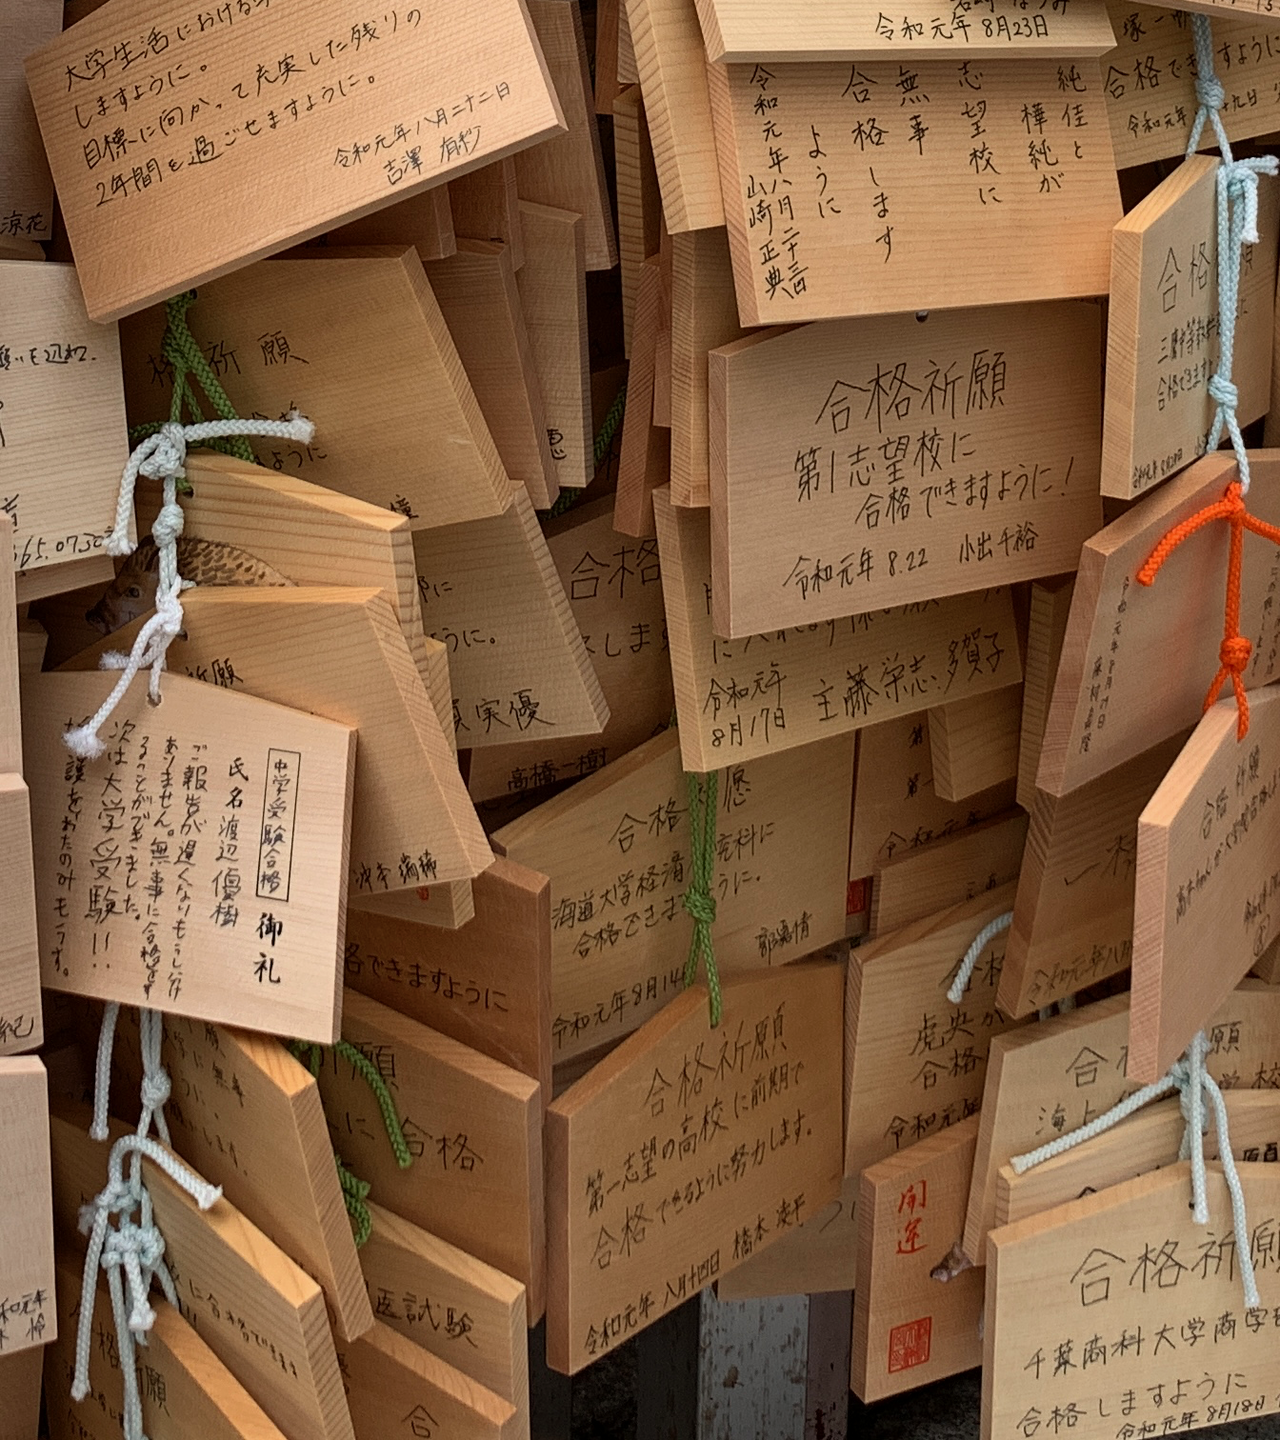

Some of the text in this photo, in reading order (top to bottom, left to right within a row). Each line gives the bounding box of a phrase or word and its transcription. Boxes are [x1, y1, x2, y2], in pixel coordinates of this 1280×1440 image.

[874, 12, 1050, 42] 令和元年8月23日
[807, 124, 842, 220] ように
[841, 64, 899, 264] 合格します
[957, 60, 1003, 207] 志望校に
[814, 348, 1008, 434] 合格祈願
[795, 428, 977, 503] 第1志望校に
[552, 970, 688, 1038] 令和元年8月14
[643, 1002, 789, 1119] 合格祈願
[1016, 1369, 1249, 1438] 合格しますように
